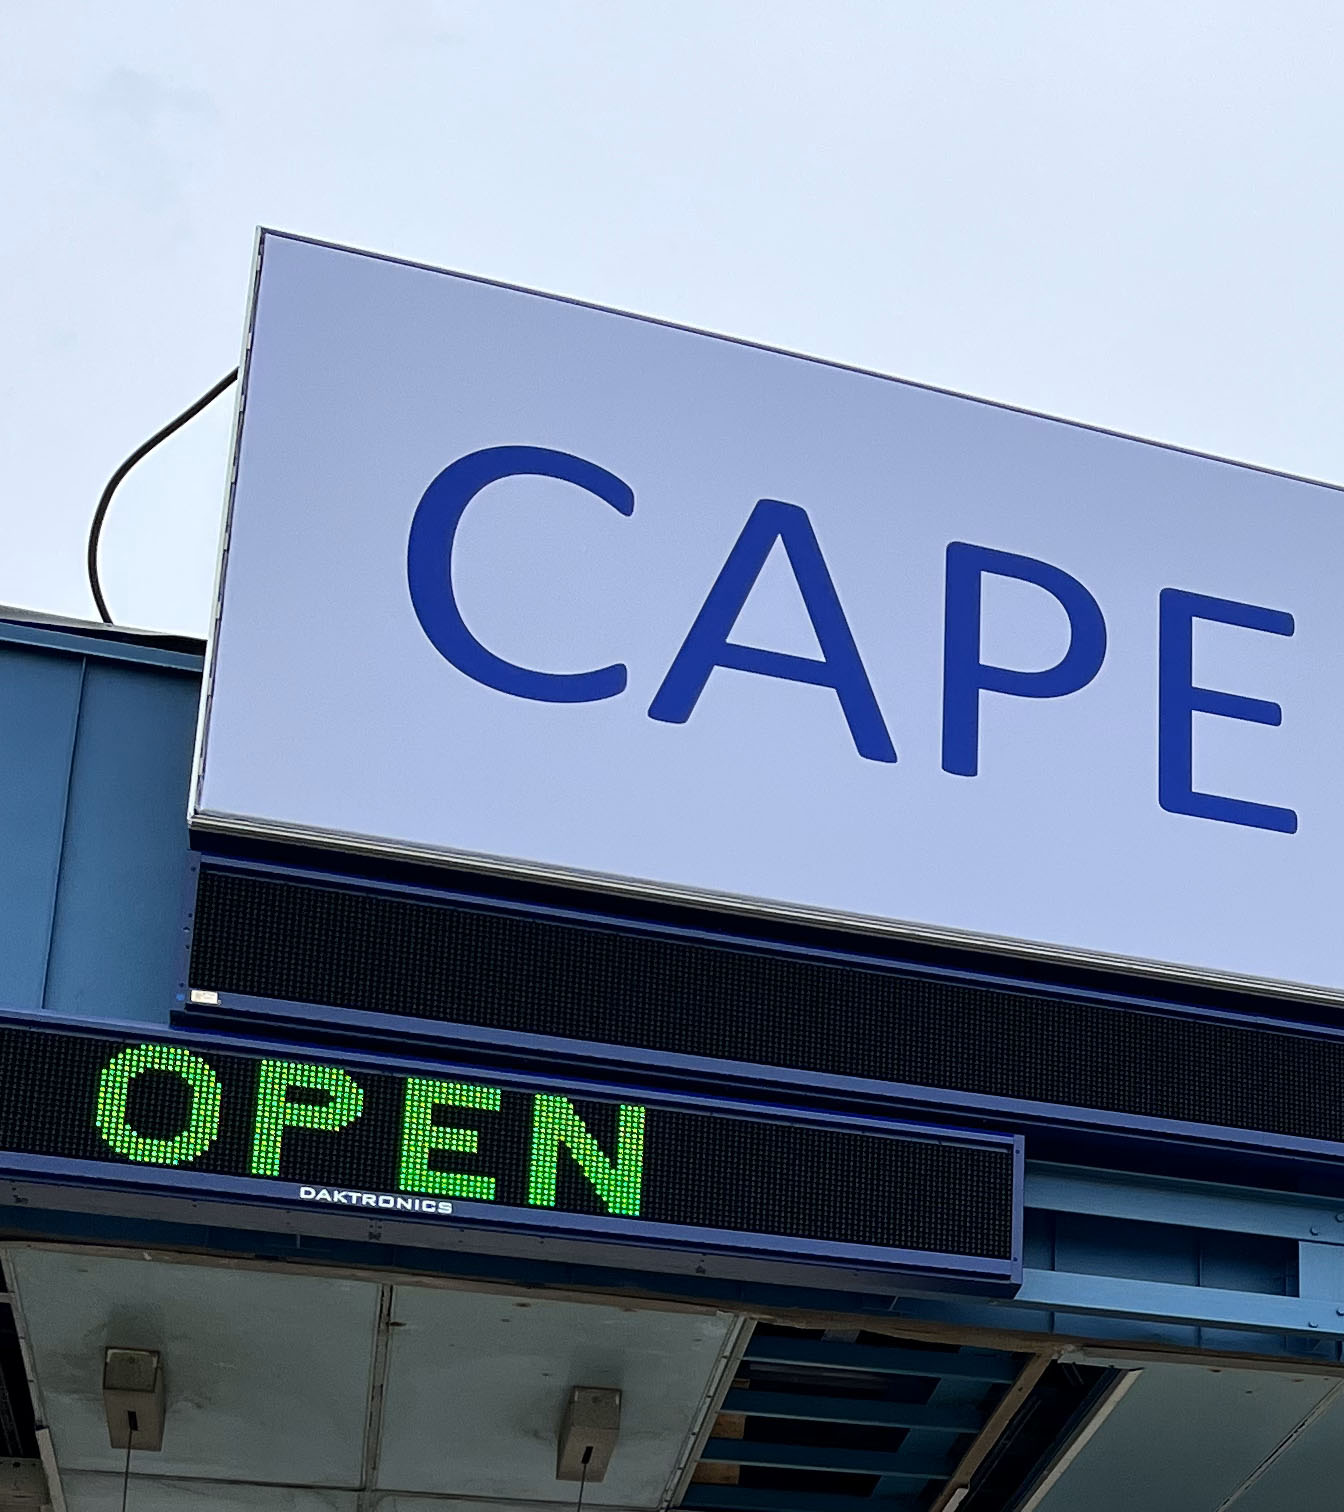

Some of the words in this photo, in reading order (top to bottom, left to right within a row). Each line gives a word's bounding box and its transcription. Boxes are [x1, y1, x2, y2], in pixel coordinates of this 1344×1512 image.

[408, 445, 1297, 834] CAPE
[96, 1043, 645, 1216] OPEN
[299, 1186, 453, 1214] DAKTRONICS
